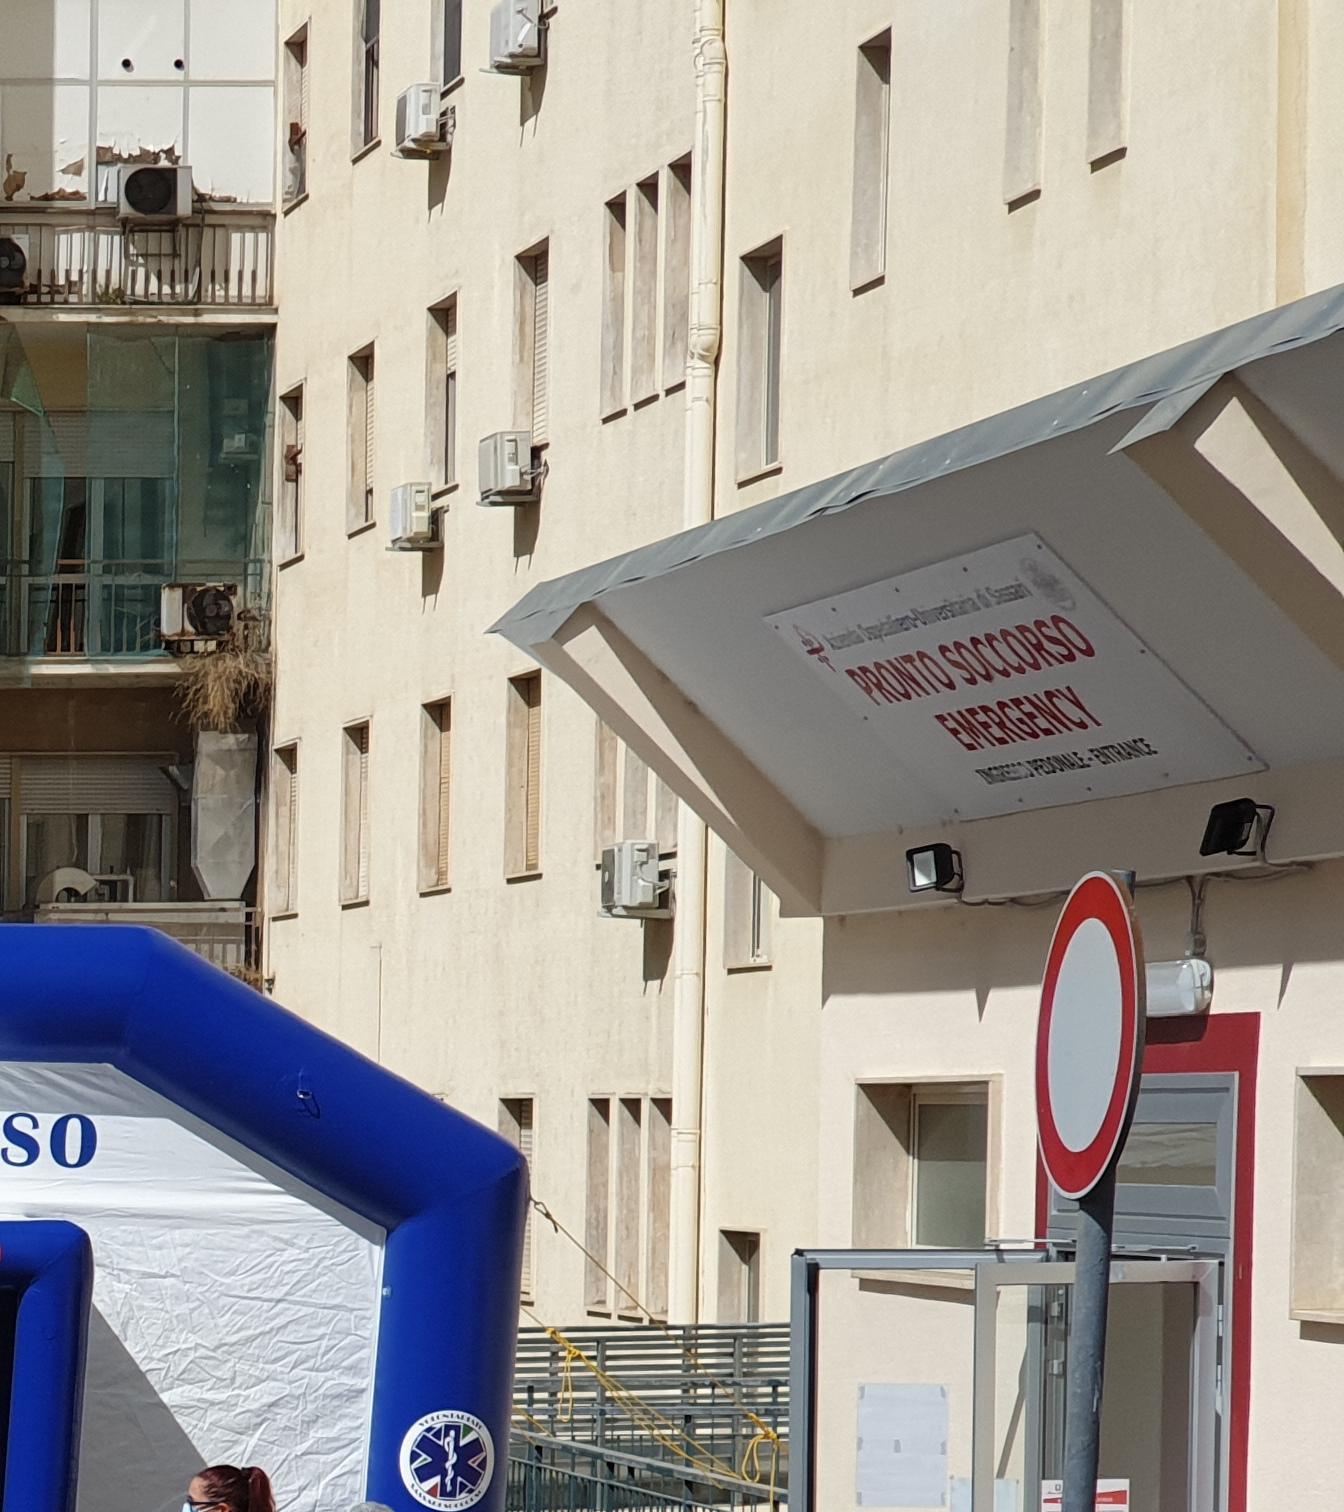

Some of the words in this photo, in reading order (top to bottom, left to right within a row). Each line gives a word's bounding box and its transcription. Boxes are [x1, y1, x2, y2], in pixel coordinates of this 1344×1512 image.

[844, 650, 957, 706] PRONTO
[938, 614, 1096, 686] SOCCORSO
[934, 685, 1102, 752] EMERGENCY
[1090, 737, 1158, 765] ENTRANCE
